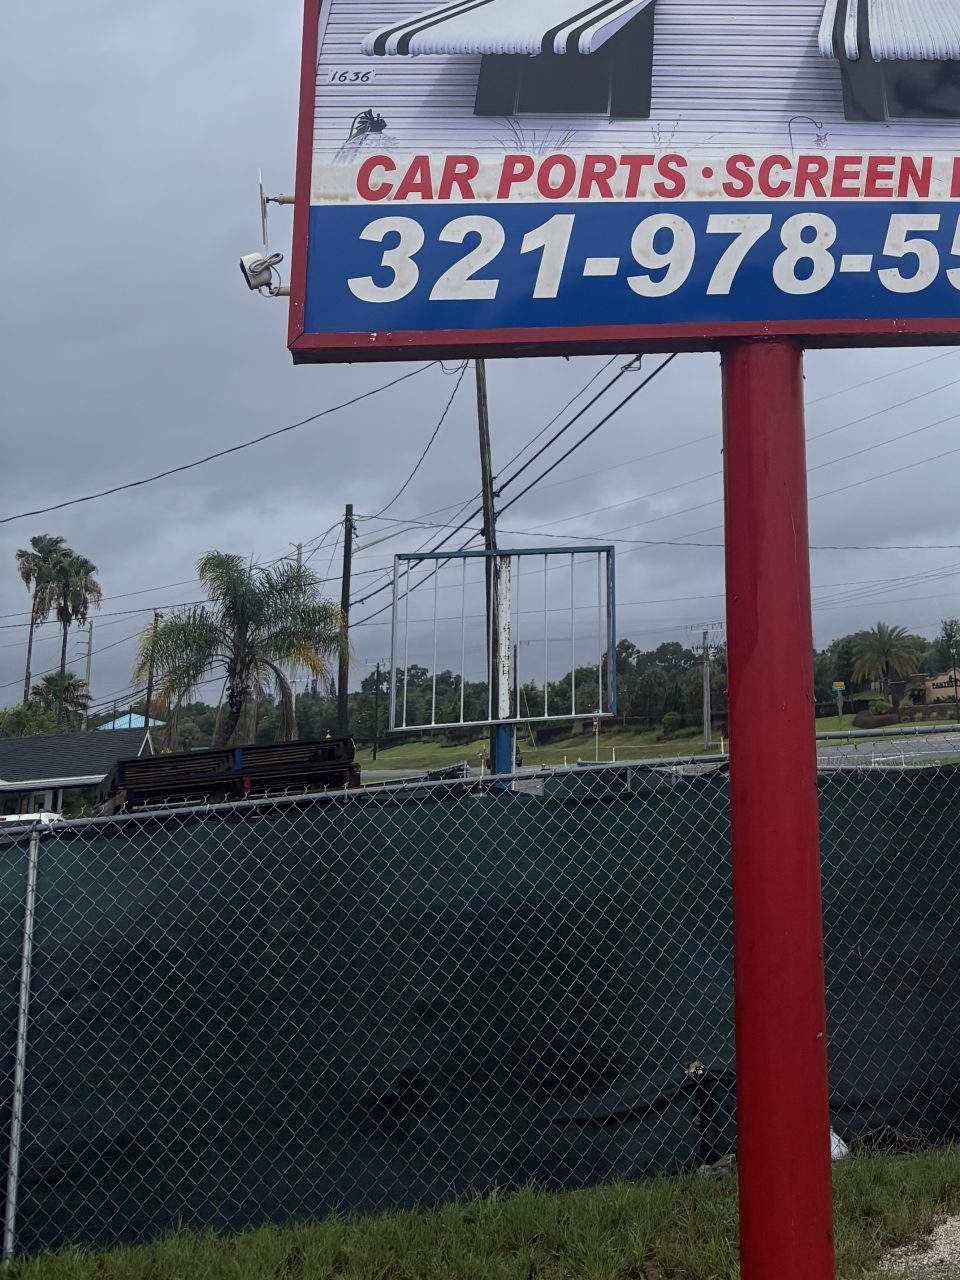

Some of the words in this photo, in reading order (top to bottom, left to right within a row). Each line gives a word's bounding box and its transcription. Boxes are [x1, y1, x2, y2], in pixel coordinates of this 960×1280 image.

[331, 70, 371, 83] 1636
[355, 155, 480, 202] CAR
[497, 154, 688, 200] PORTS
[722, 154, 933, 199] SCREEN
